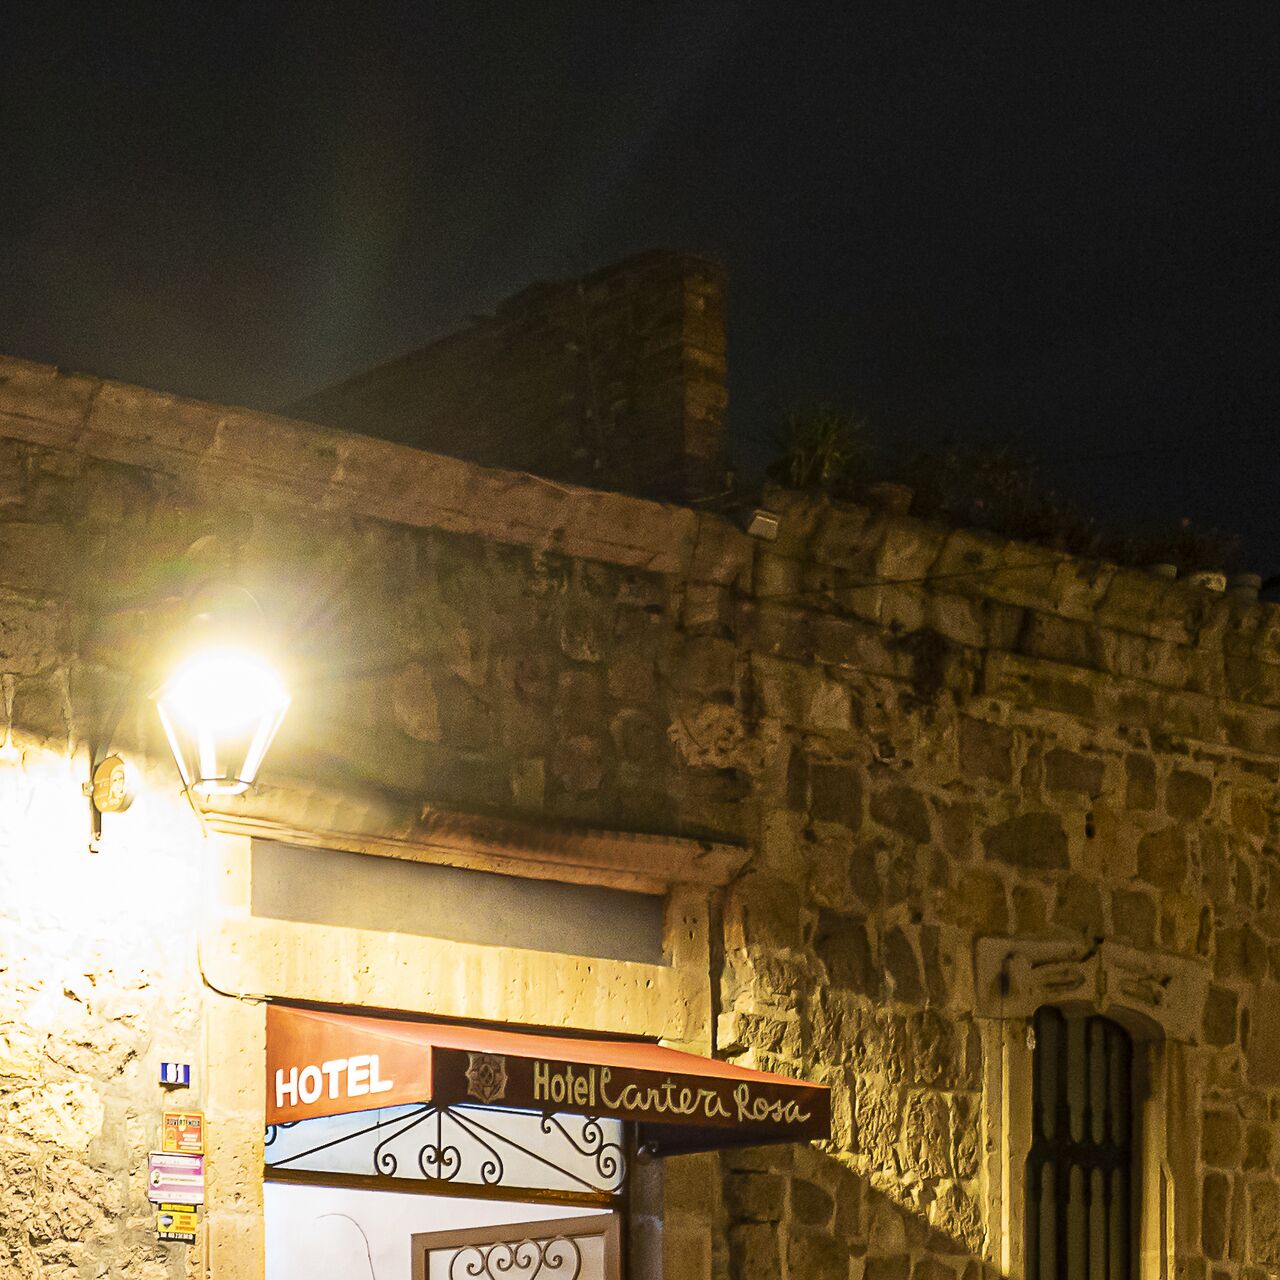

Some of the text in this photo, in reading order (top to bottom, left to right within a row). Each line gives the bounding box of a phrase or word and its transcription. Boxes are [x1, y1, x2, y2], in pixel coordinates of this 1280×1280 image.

[275, 1054, 394, 1108] HOTEL
[533, 1061, 811, 1123] Hotel Cantera Rosa
